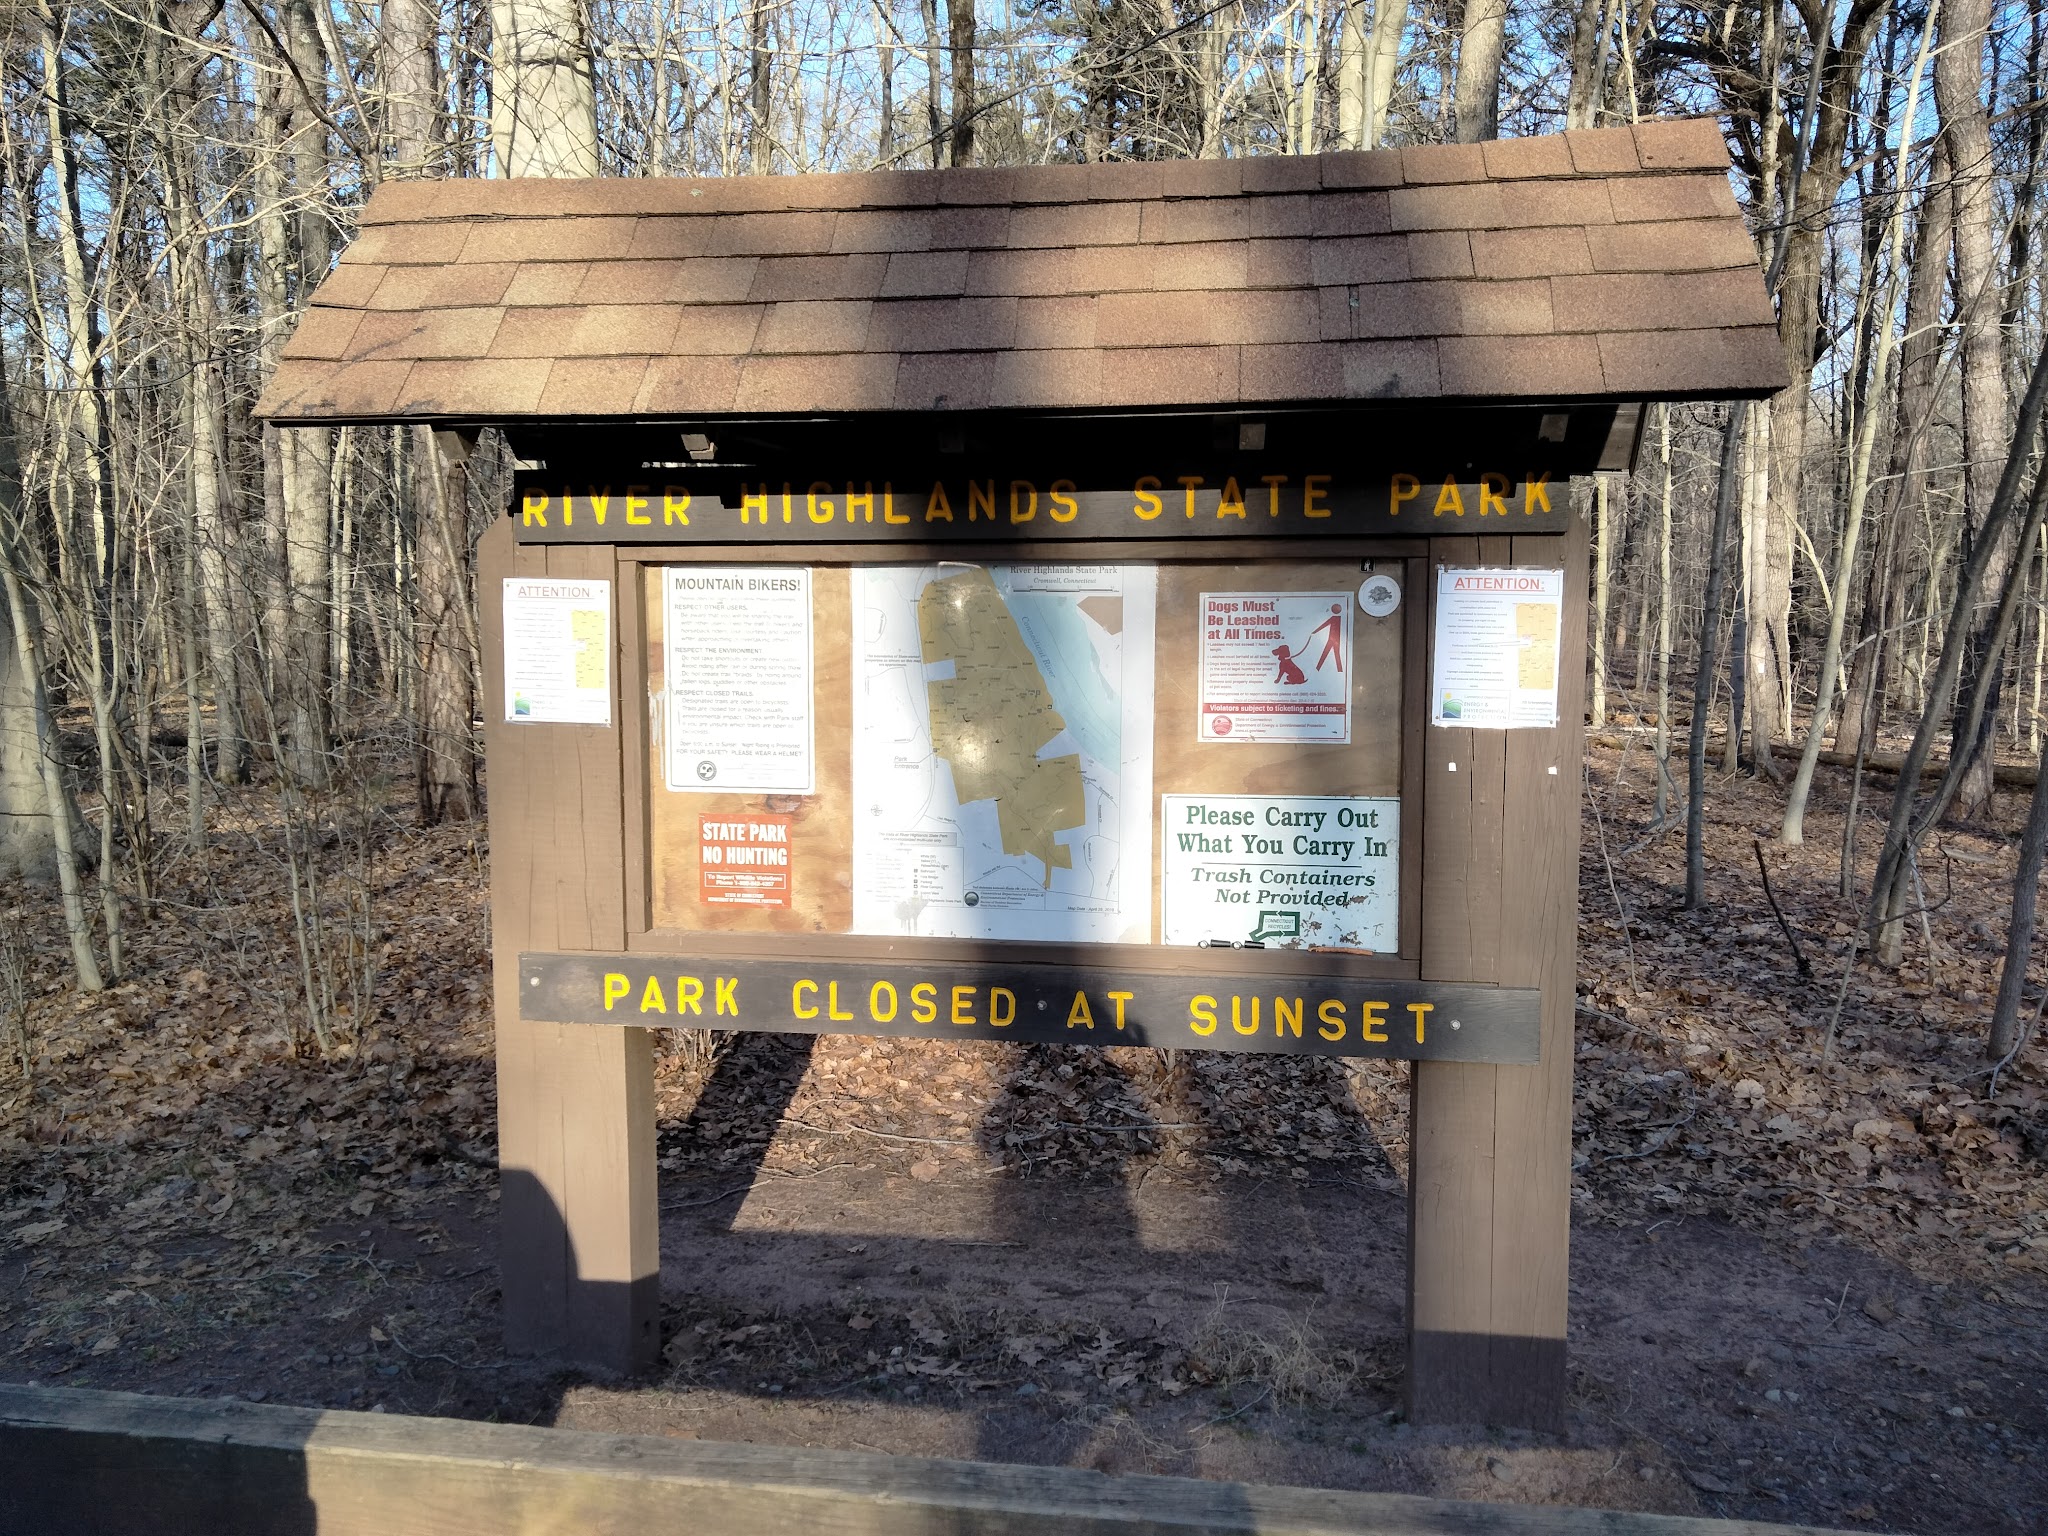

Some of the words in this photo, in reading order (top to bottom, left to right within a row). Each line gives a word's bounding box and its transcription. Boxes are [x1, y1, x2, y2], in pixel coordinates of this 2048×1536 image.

[522, 485, 691, 527] RIVER
[740, 479, 1078, 525] HIGHLANDS
[1133, 475, 1332, 520] STATE
[1389, 471, 1552, 517] PARK
[1009, 565, 1031, 574] River
[1033, 565, 1074, 575] Highlands
[1075, 565, 1097, 574] State
[1099, 565, 1118, 574] Park
[675, 577, 744, 590] MOUNTAIN
[748, 579, 801, 591] BIKERS!
[1208, 600, 1239, 613] Dogs
[1242, 600, 1275, 612] Must
[1207, 614, 1224, 626] Be
[1227, 614, 1279, 626] Leashed
[1207, 629, 1221, 640] at
[1224, 628, 1240, 640] All
[1243, 628, 1285, 640] Times.
[1021, 616, 1047, 658] Connecticut
[1042, 658, 1056, 679] River
[1209, 704, 1240, 712] Violators
[1240, 705, 1266, 713] subject
[1275, 704, 1304, 713] ticketing
[1186, 804, 1255, 825] Please
[1265, 806, 1327, 832] Carry
[1337, 807, 1379, 829] Out
[702, 822, 746, 841] STATE
[749, 823, 788, 842] PARK
[702, 845, 723, 864] NO
[725, 846, 788, 866] HUNTING
[1177, 832, 1233, 854] What
[1241, 834, 1284, 855] You
[1293, 834, 1355, 861] Carry
[1363, 836, 1388, 857] In
[1190, 867, 1252, 883] Trash
[1259, 869, 1376, 887] Containers
[1214, 888, 1250, 904] Not
[1256, 889, 1349, 906] Provided
[603, 972, 740, 1018] PARK
[792, 978, 1017, 1028] CLOSED
[1066, 990, 1134, 1031] AT
[1189, 994, 1435, 1045] SUNSET
